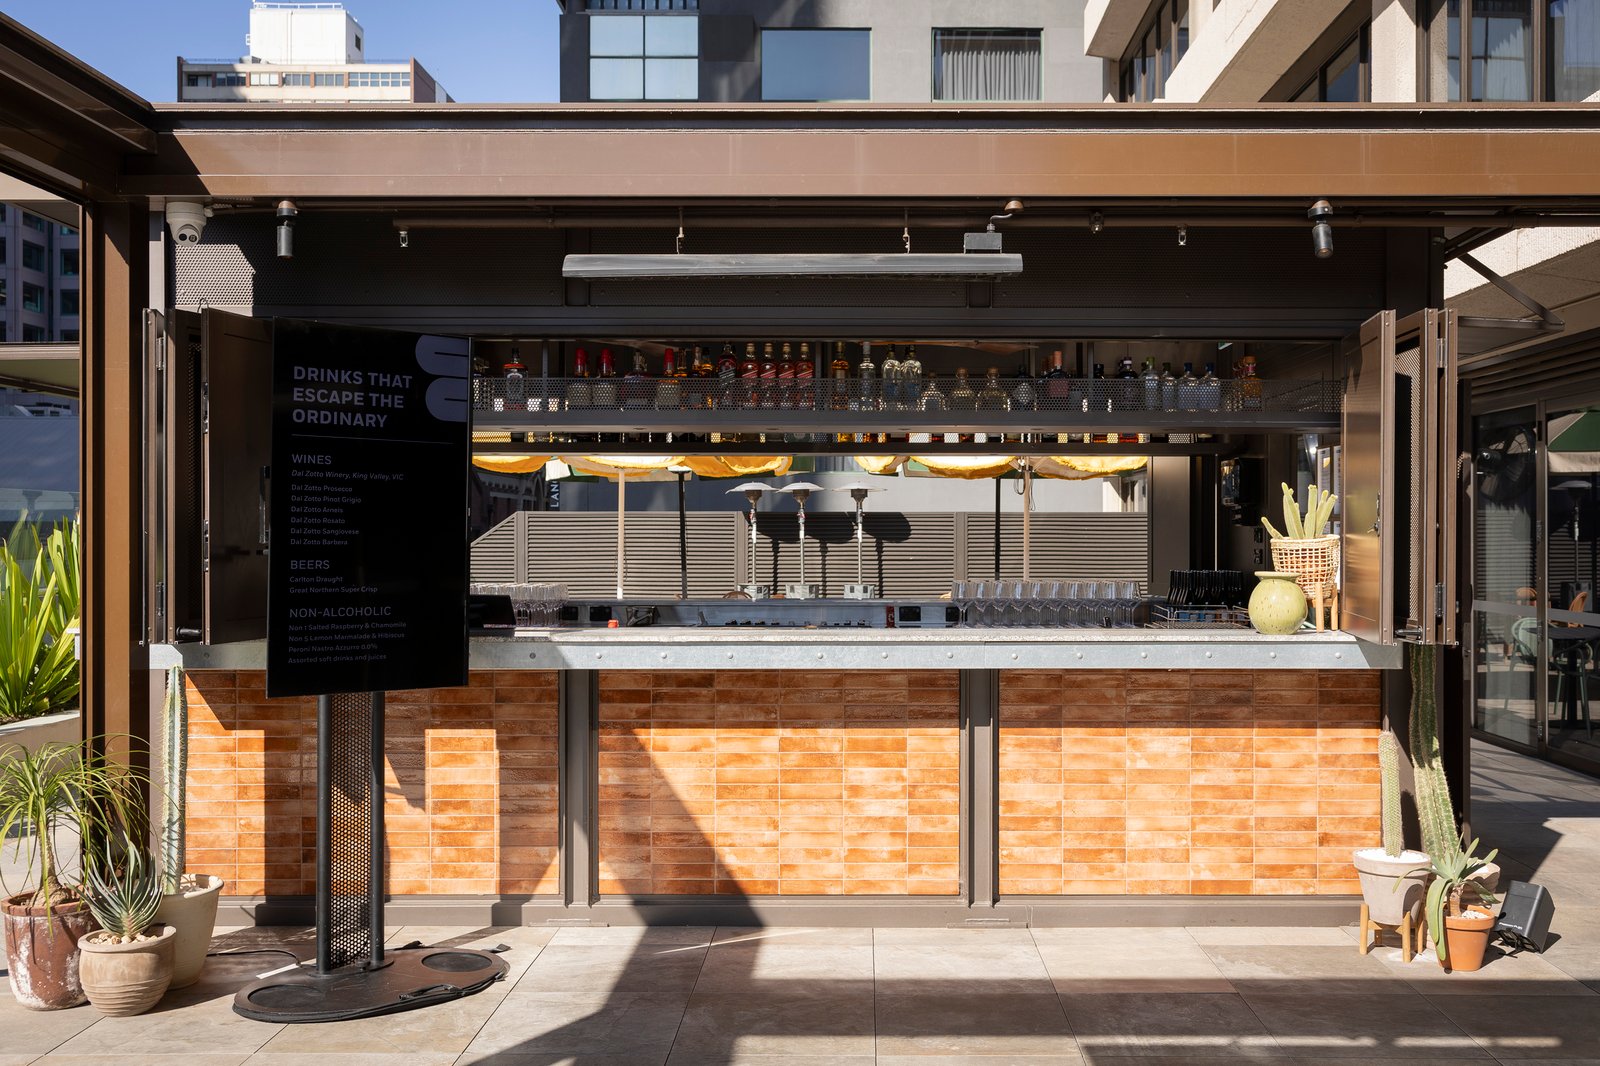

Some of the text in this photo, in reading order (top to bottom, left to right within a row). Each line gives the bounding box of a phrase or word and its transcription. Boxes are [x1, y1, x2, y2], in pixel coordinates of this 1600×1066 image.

[294, 366, 412, 388] DRINKS THAT
[293, 387, 404, 408] ESCAPE THE
[292, 408, 388, 428] ORDINARY
[292, 454, 332, 464] WINES
[305, 470, 324, 478] Zotto
[325, 471, 351, 480] Winery,
[352, 472, 368, 480] King
[369, 472, 390, 481] Valley,
[290, 560, 330, 570] BEERS
[290, 606, 391, 618] NON-ALCOHOLIC
